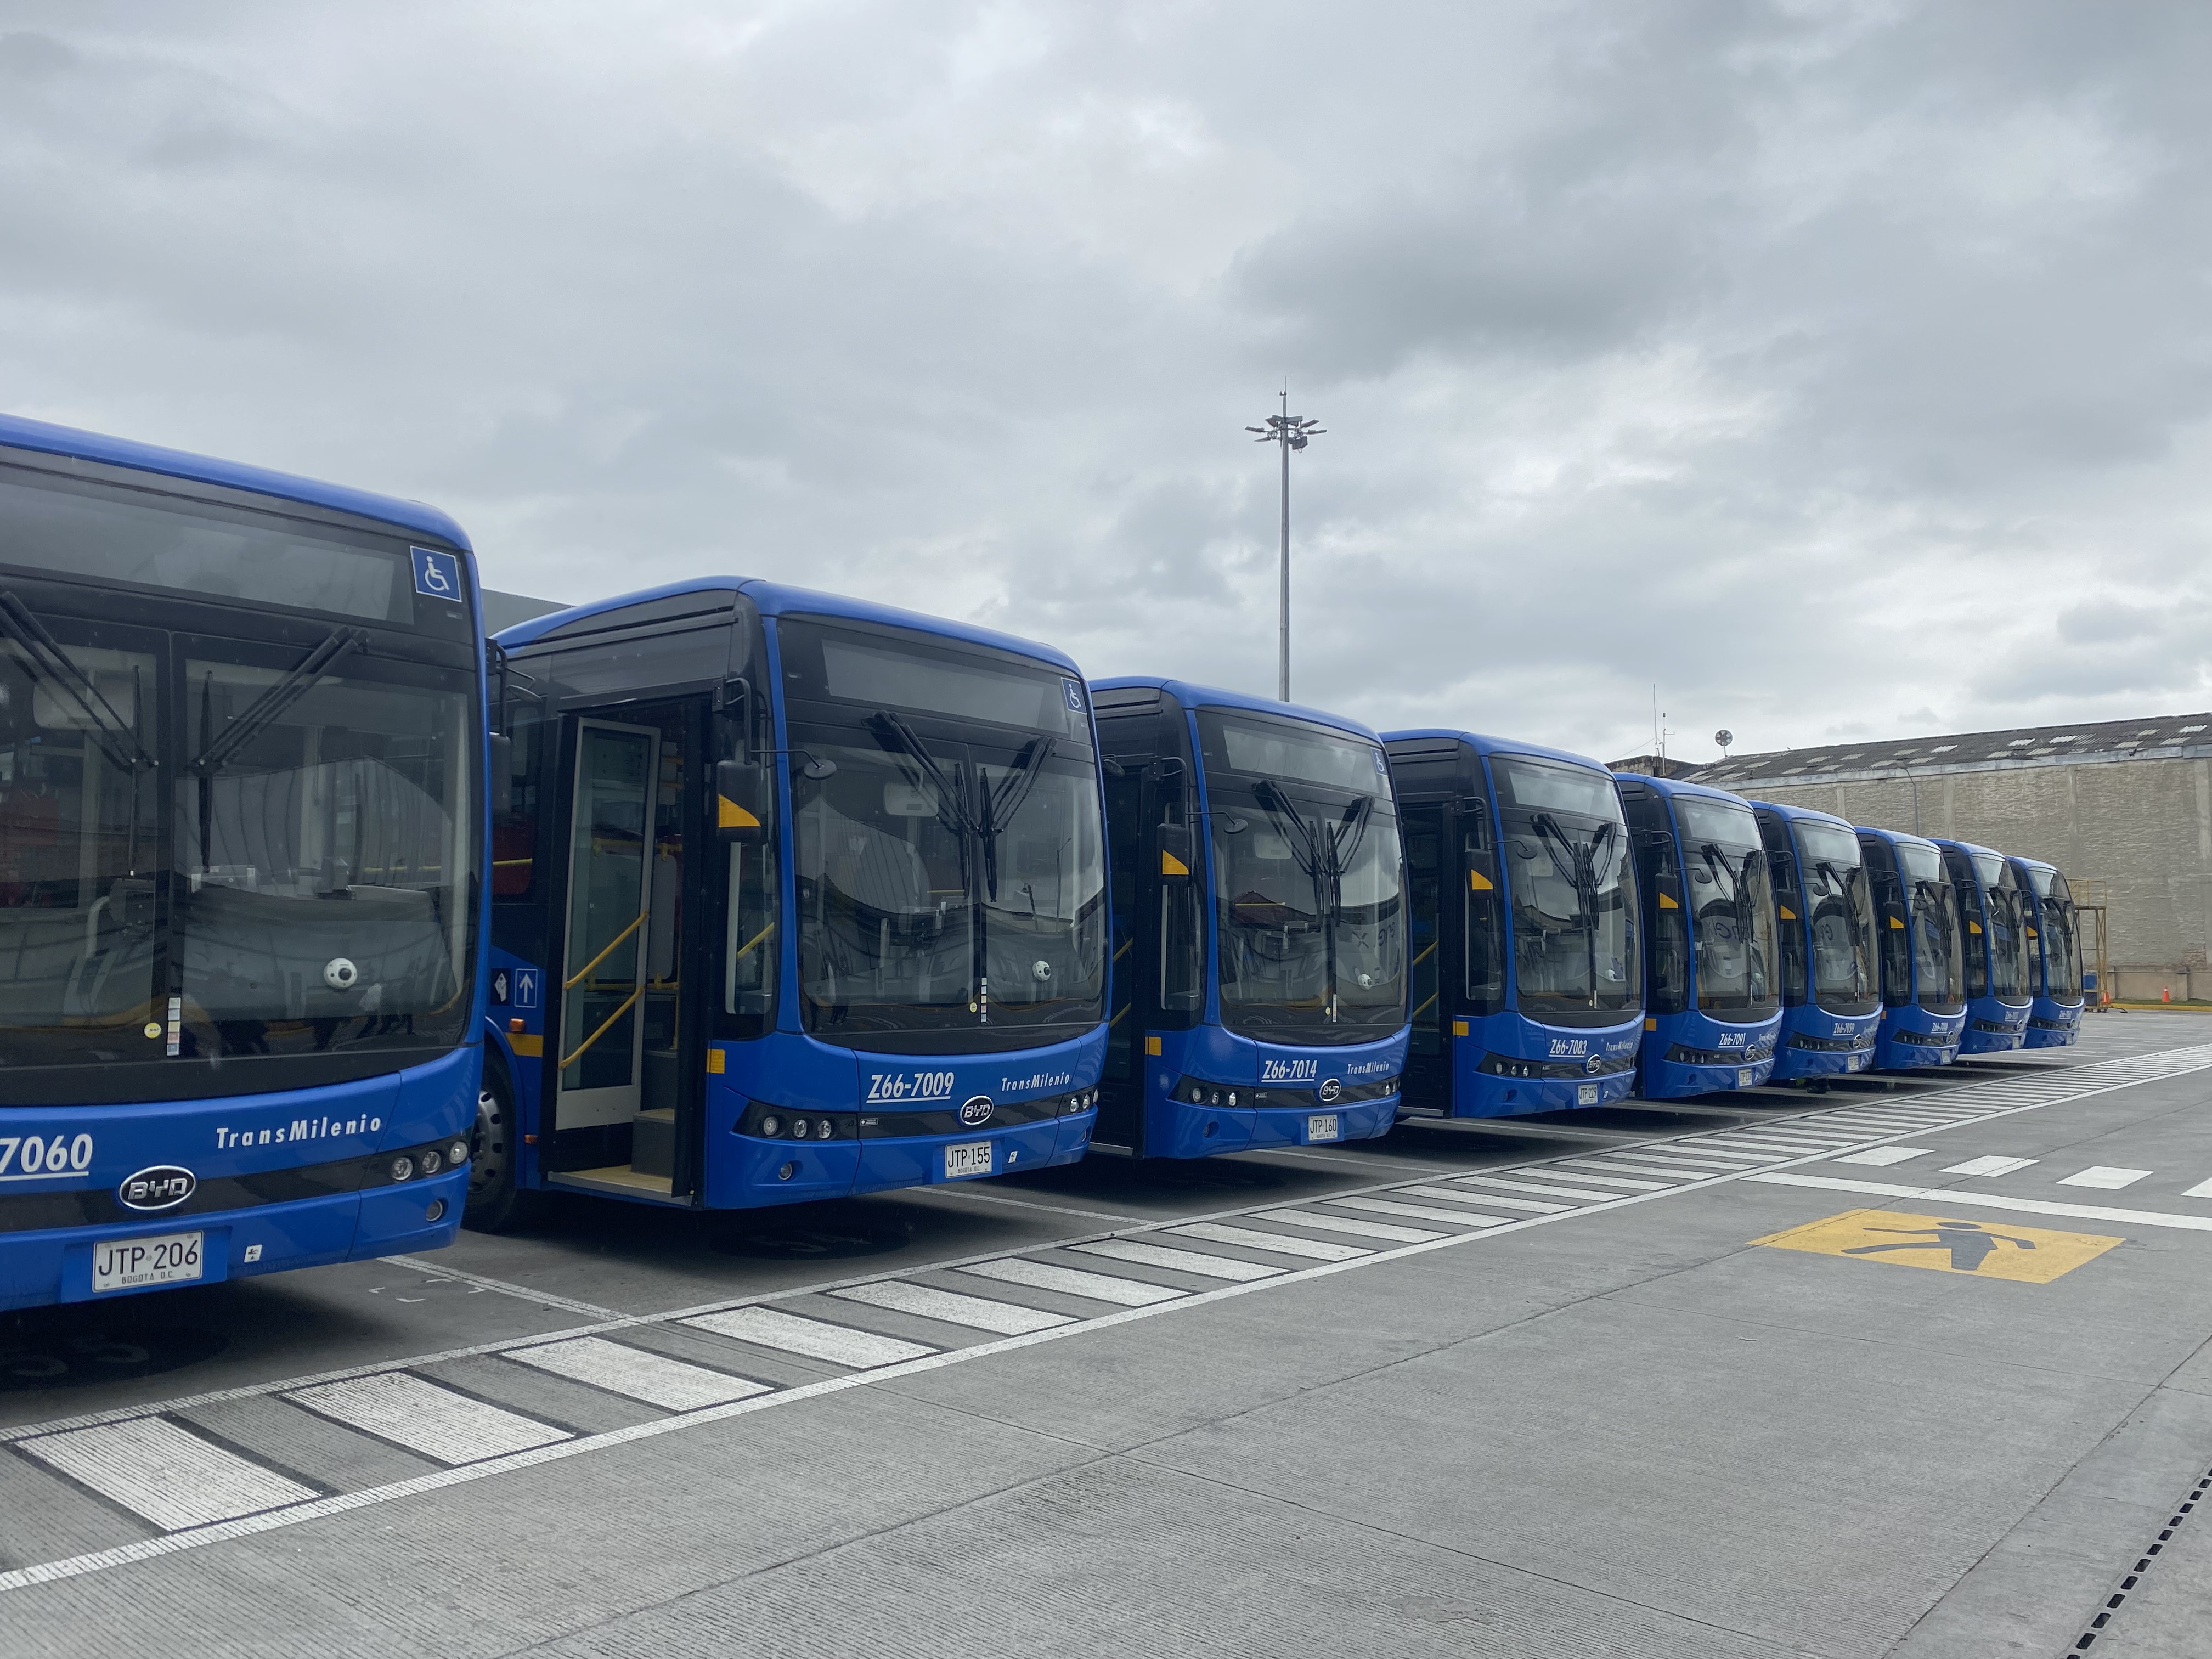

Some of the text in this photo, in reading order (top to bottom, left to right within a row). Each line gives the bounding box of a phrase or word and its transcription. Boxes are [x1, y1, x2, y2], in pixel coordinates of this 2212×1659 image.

[1549, 1039, 1588, 1055] Z66-7083
[1718, 1032, 1746, 1046] Z66-7091
[1262, 1059, 1318, 1079] Z66-7014
[1347, 1061, 1390, 1075] TransMilenio
[867, 1071, 955, 1098] Z66-7009
[1001, 1071, 1070, 1092] TransMilenio
[963, 1104, 990, 1119] BYD
[216, 1113, 382, 1149] TransMilenio
[1310, 1118, 1337, 1133] JTP 160
[0, 1133, 93, 1174] 7060
[947, 1146, 990, 1168] JTP 155
[128, 1177, 188, 1200] BYD
[98, 1239, 198, 1276] JTP 206
[121, 1273, 154, 1284] BOGOTA
